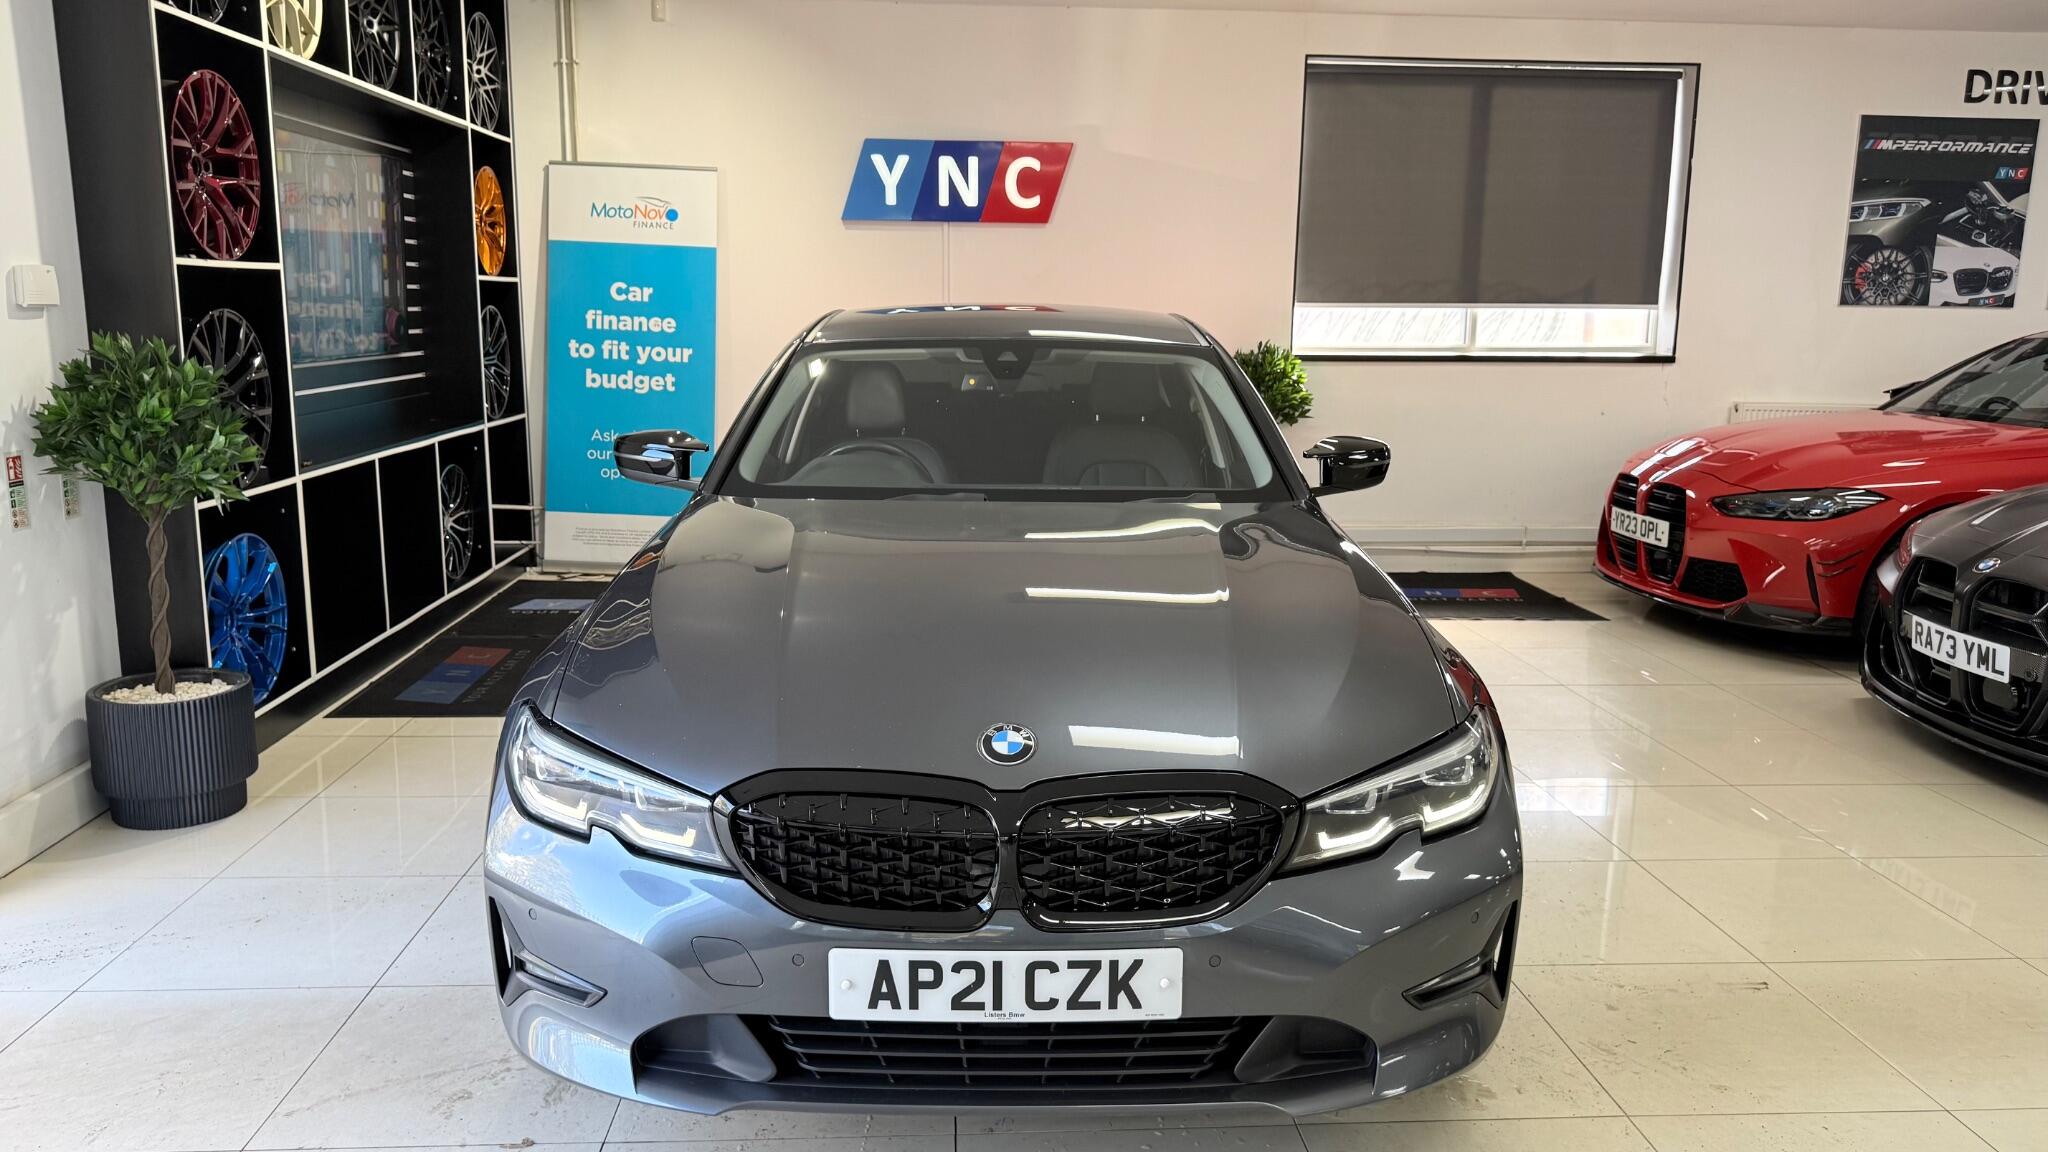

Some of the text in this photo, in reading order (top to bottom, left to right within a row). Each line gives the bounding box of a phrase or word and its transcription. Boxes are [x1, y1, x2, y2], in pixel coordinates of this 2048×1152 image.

[870, 153, 1041, 209] YNC
[1999, 168, 2025, 179] YNC
[632, 220, 675, 230] FINANCE
[609, 281, 653, 302] Car
[585, 309, 676, 333] finance
[568, 339, 693, 365] to fit your
[585, 368, 676, 394] budget
[591, 428, 619, 442] Ask
[586, 449, 613, 460] our
[1614, 510, 1662, 543] YR23 OPL
[1914, 620, 2005, 677] RA73 YML
[987, 724, 1031, 738] BMW
[867, 958, 1145, 1011] AP21 CZK
